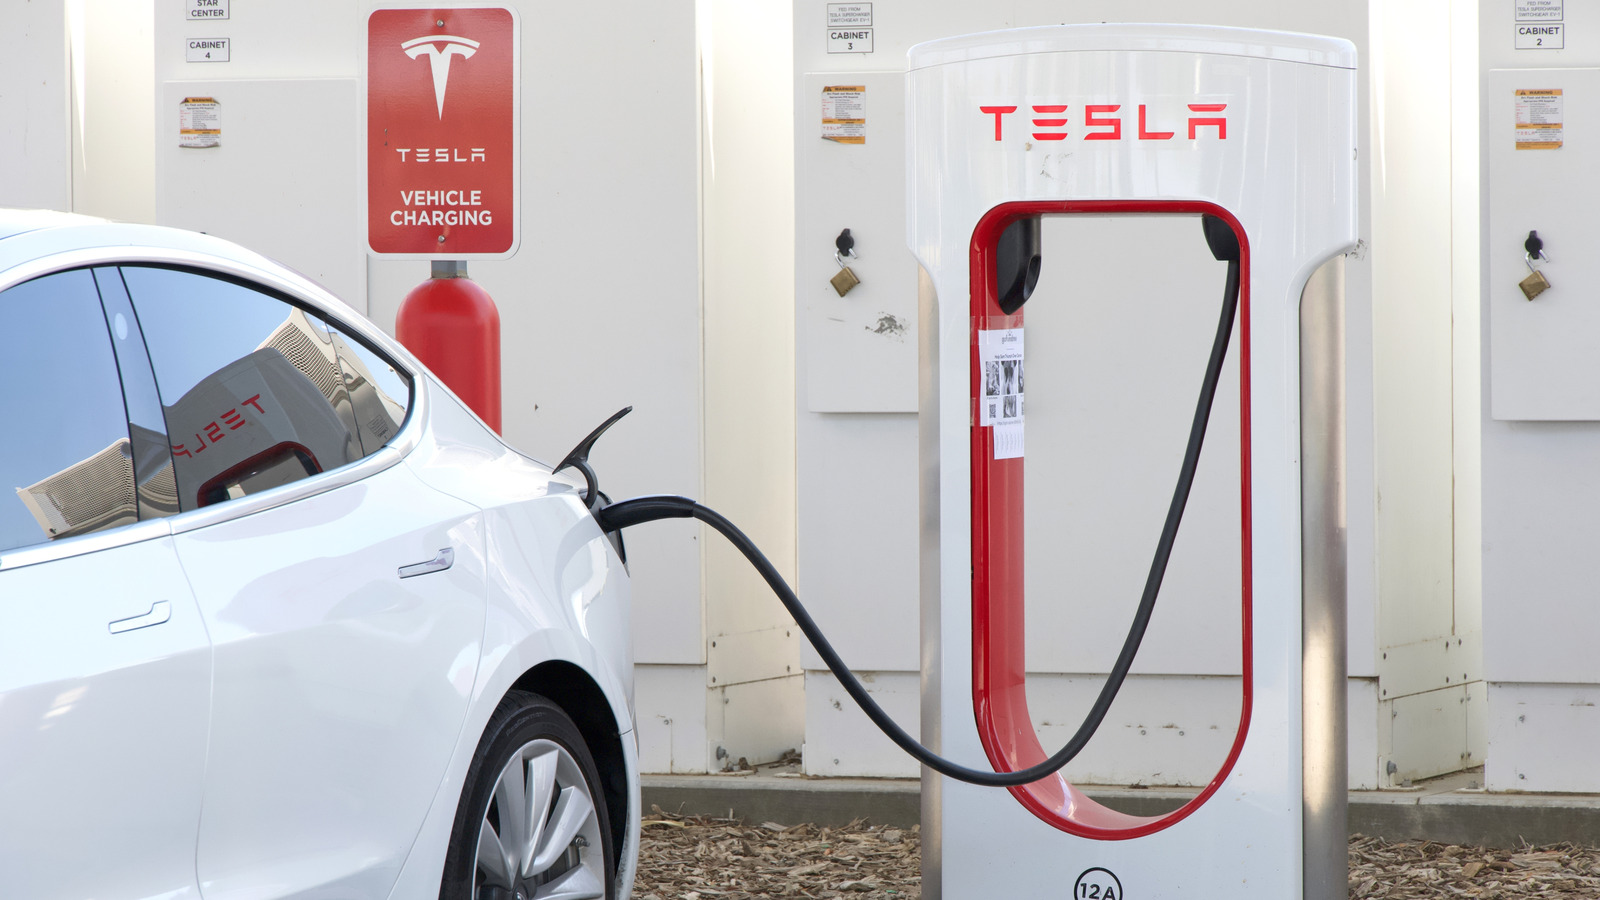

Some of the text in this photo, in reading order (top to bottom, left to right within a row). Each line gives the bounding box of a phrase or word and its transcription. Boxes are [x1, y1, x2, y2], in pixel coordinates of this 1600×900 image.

[191, 9, 225, 17] CENTER
[1519, 27, 1560, 35] CABINET
[189, 41, 226, 49] CABINET
[1537, 38, 1542, 46] 2
[979, 103, 1228, 142] TESLA
[396, 148, 486, 163] TESLA
[400, 190, 482, 206] VEHICLE
[390, 210, 492, 226] CHARGING
[1080, 882, 1116, 900] 12A
